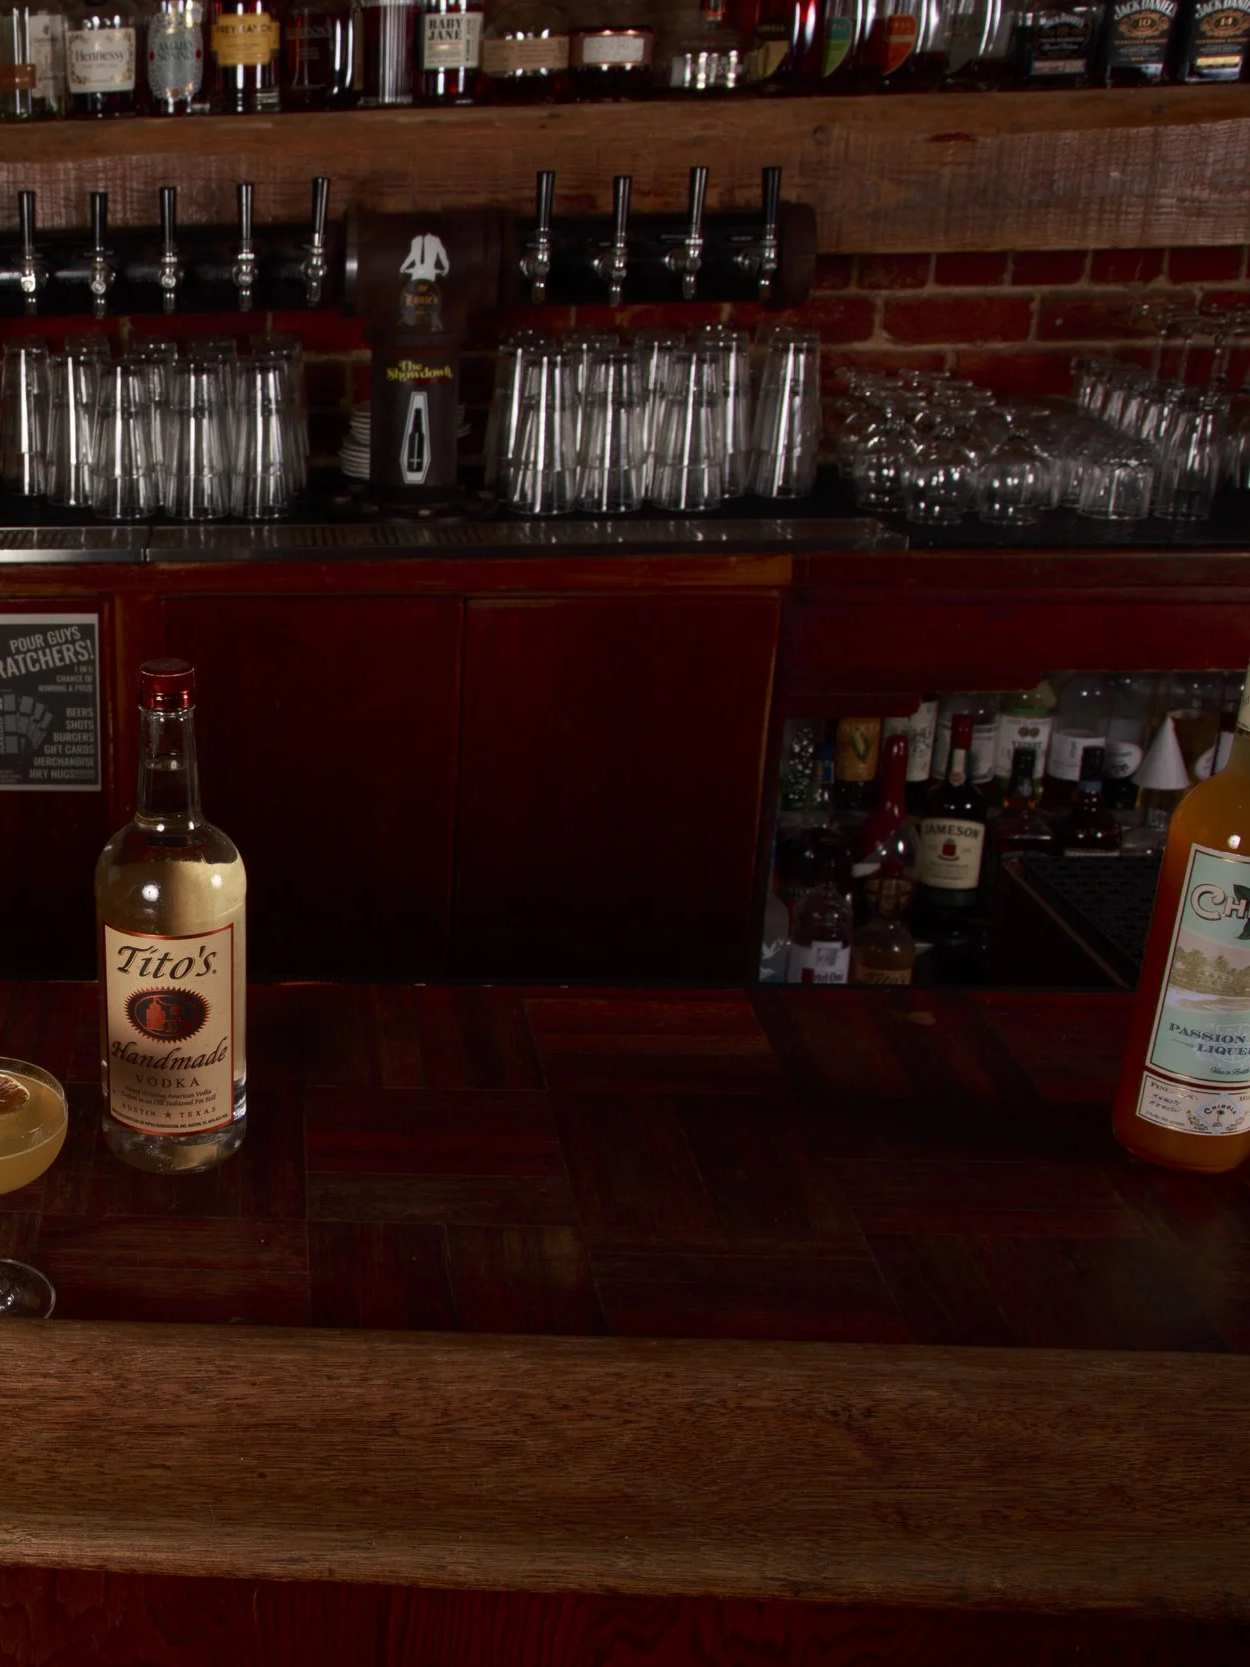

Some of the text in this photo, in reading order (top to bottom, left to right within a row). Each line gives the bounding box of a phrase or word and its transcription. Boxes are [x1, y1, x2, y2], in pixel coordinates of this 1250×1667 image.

[428, 18, 462, 31] BABY
[428, 30, 462, 42] JANE
[75, 50, 124, 62] Hennessy
[398, 359, 422, 371] The
[9, 626, 81, 654] POUR GUYS
[66, 707, 94, 718] BEERS
[65, 720, 94, 730] SHOTS
[53, 732, 95, 743] BURGERS
[44, 745, 95, 755] GIFT CARDS
[33, 757, 95, 767] MERCHANDISE
[922, 823, 979, 840] JAMESON
[117, 945, 216, 980] Tito's
[1168, 1022, 1246, 1043] PASSION
[111, 1036, 228, 1070] Handmade
[135, 1073, 200, 1088] VODKA
[195, 1088, 212, 1097] Vodka
[122, 1103, 156, 1117] AUSTIN
[179, 1106, 216, 1118] TEXAS
